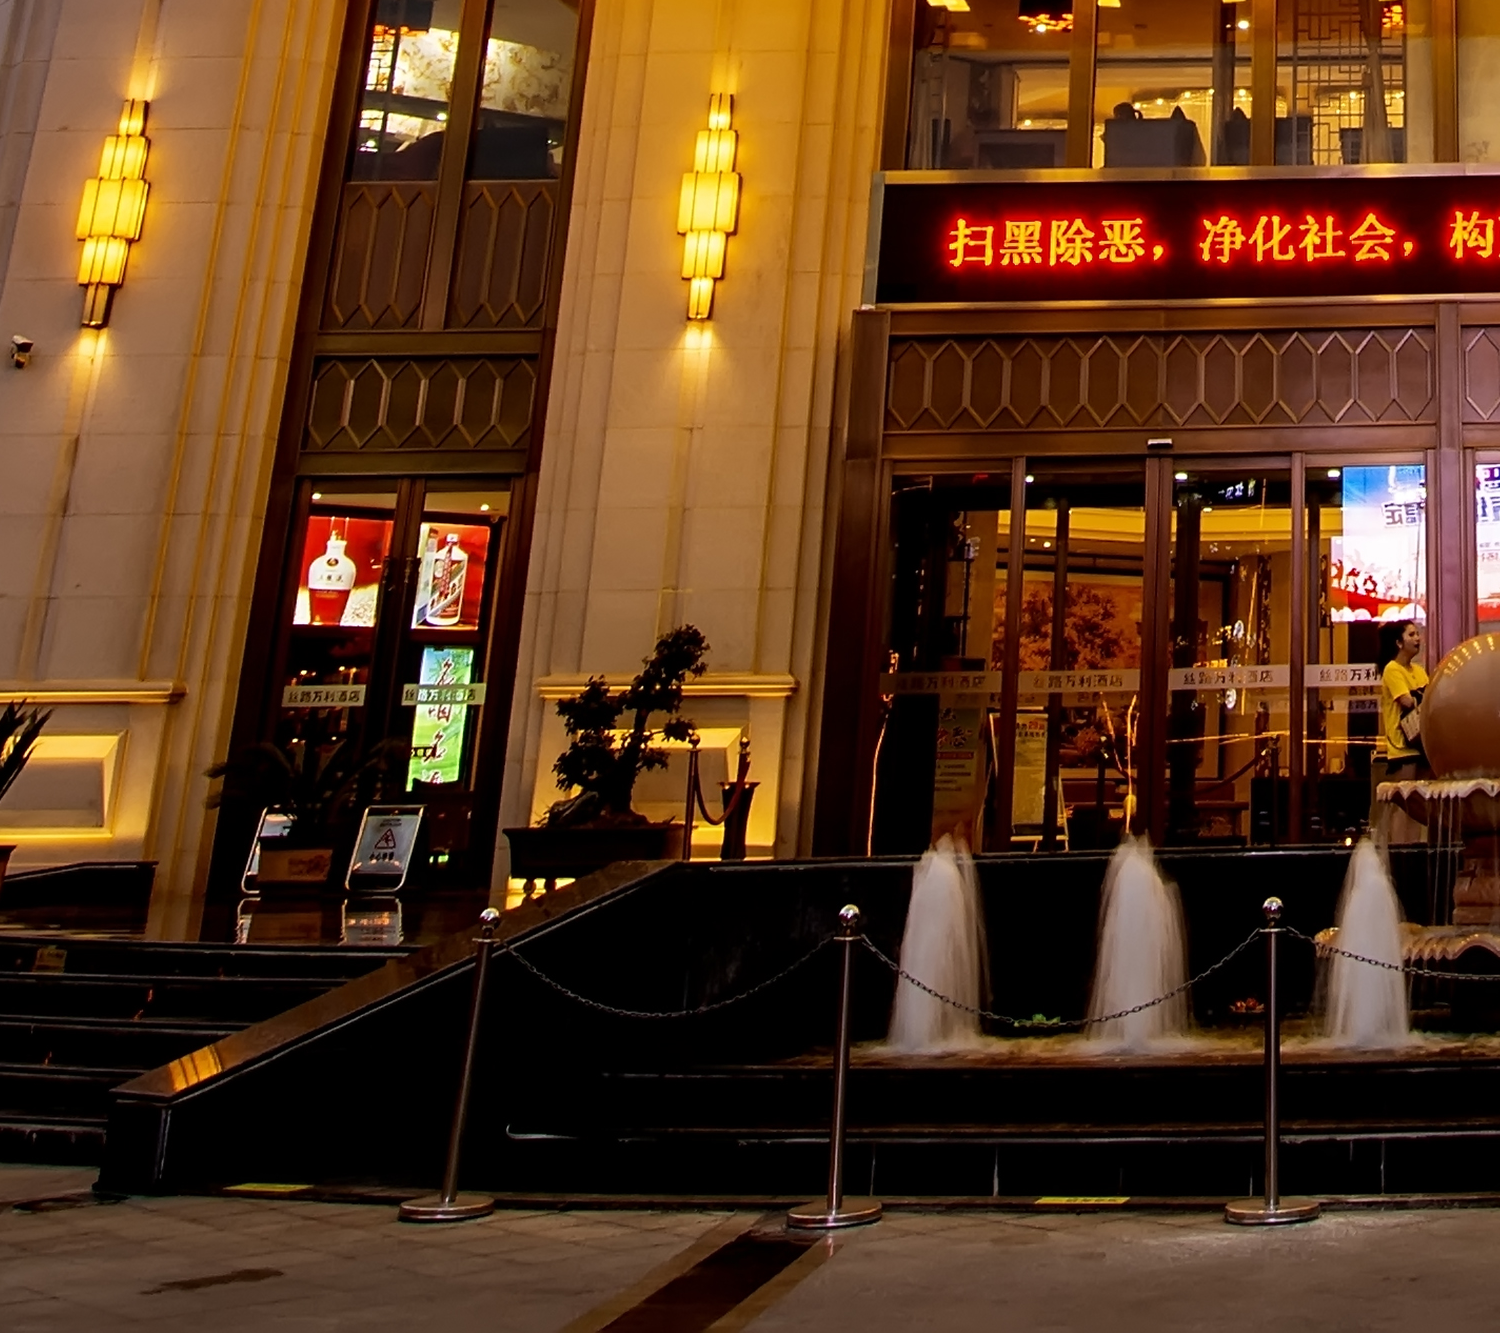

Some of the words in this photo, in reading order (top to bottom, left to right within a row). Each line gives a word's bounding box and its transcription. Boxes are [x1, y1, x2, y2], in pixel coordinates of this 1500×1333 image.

[287, 690, 361, 704] 丝路万利酒店
